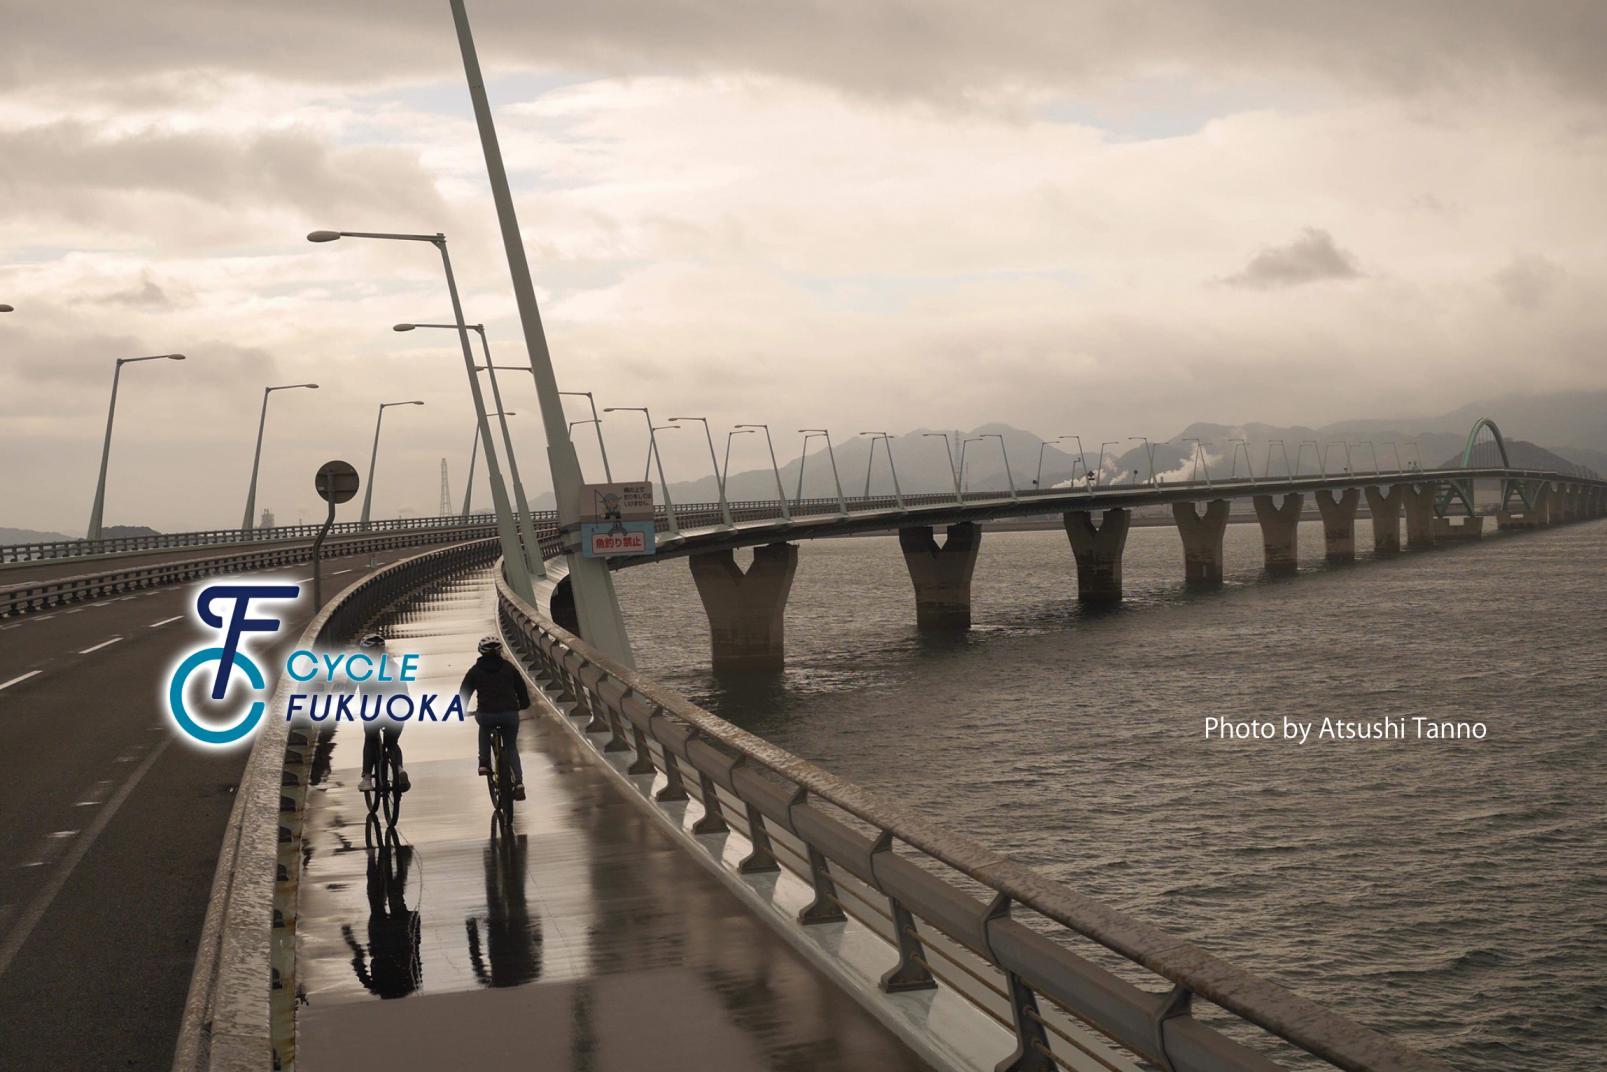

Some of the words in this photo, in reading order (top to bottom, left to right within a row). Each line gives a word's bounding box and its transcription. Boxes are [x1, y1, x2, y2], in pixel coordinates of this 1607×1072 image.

[596, 536, 642, 548] 魚釣り禁止
